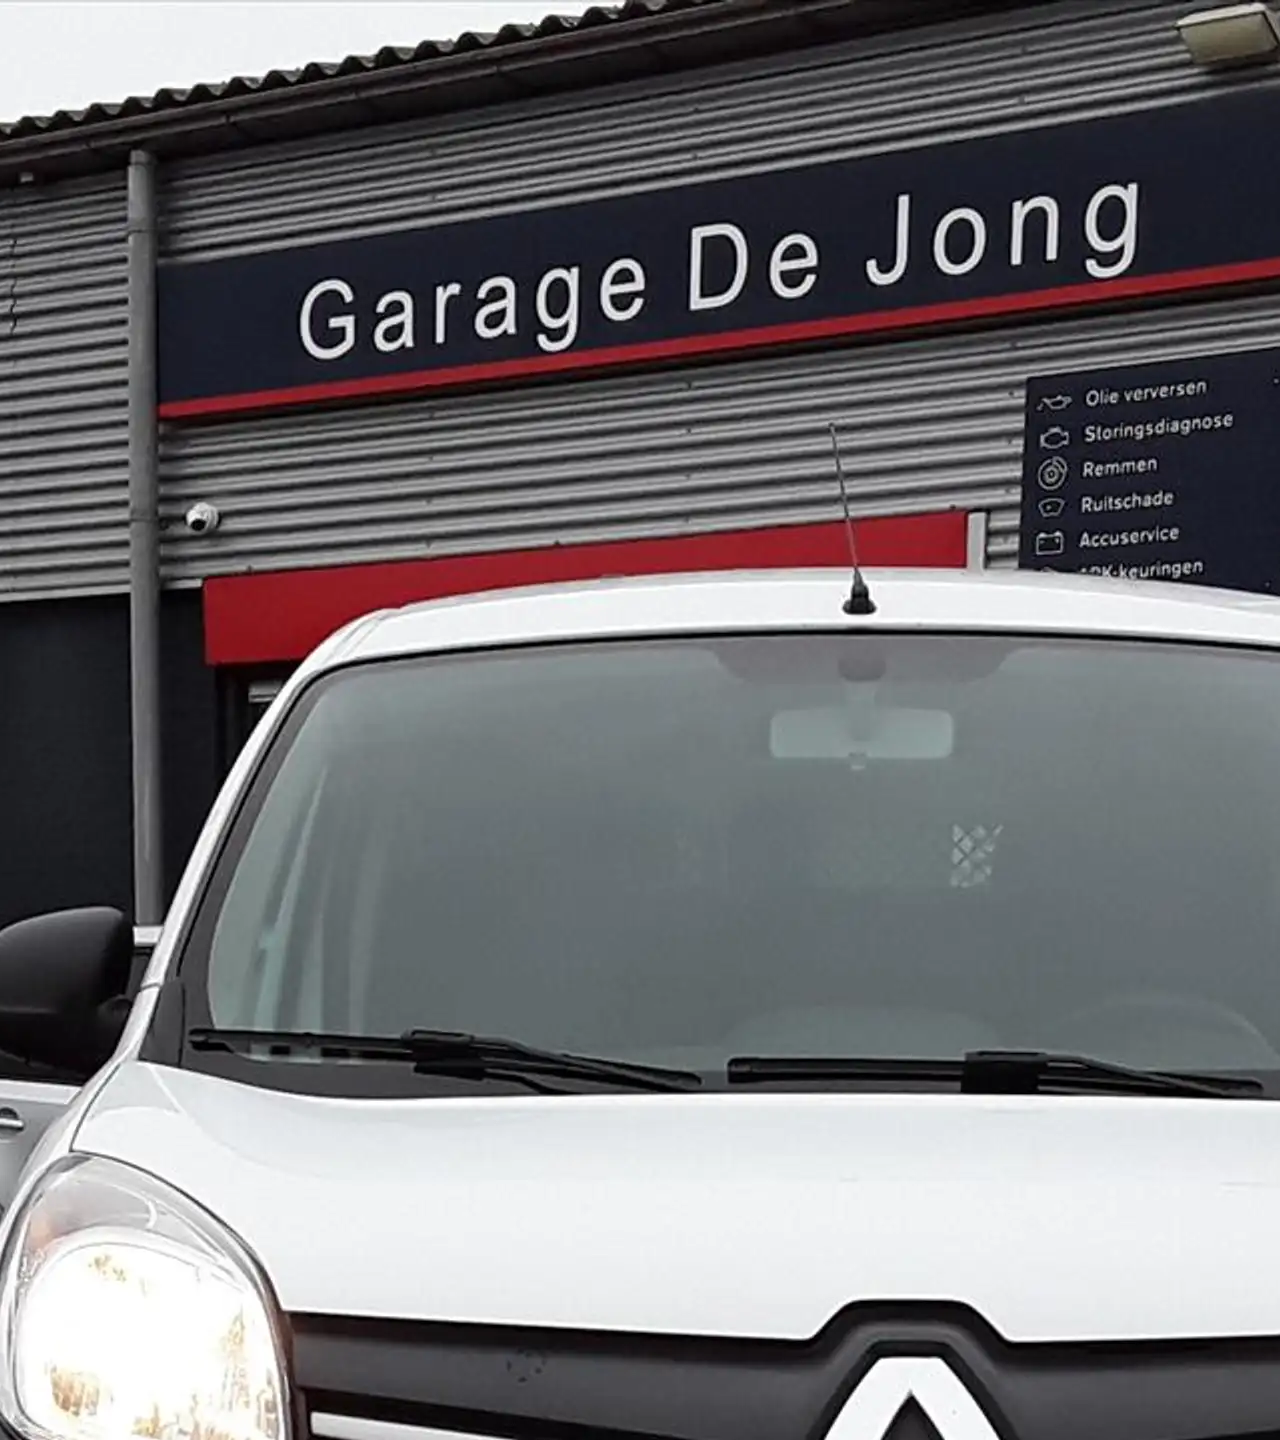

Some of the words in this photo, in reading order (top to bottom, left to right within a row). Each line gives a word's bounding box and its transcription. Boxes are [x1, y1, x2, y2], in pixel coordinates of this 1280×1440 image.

[299, 253, 646, 361] Garage
[688, 223, 819, 312] De
[865, 181, 1142, 287] Jong
[1085, 388, 1119, 408] Olie
[1124, 380, 1207, 402] verversen
[1084, 411, 1234, 444] Storingsdiagnose
[1082, 456, 1158, 479] Remmen
[1080, 491, 1174, 514] Ruitschade
[1078, 525, 1180, 549] Accuservice
[1080, 561, 1204, 580] PK-keuringen
